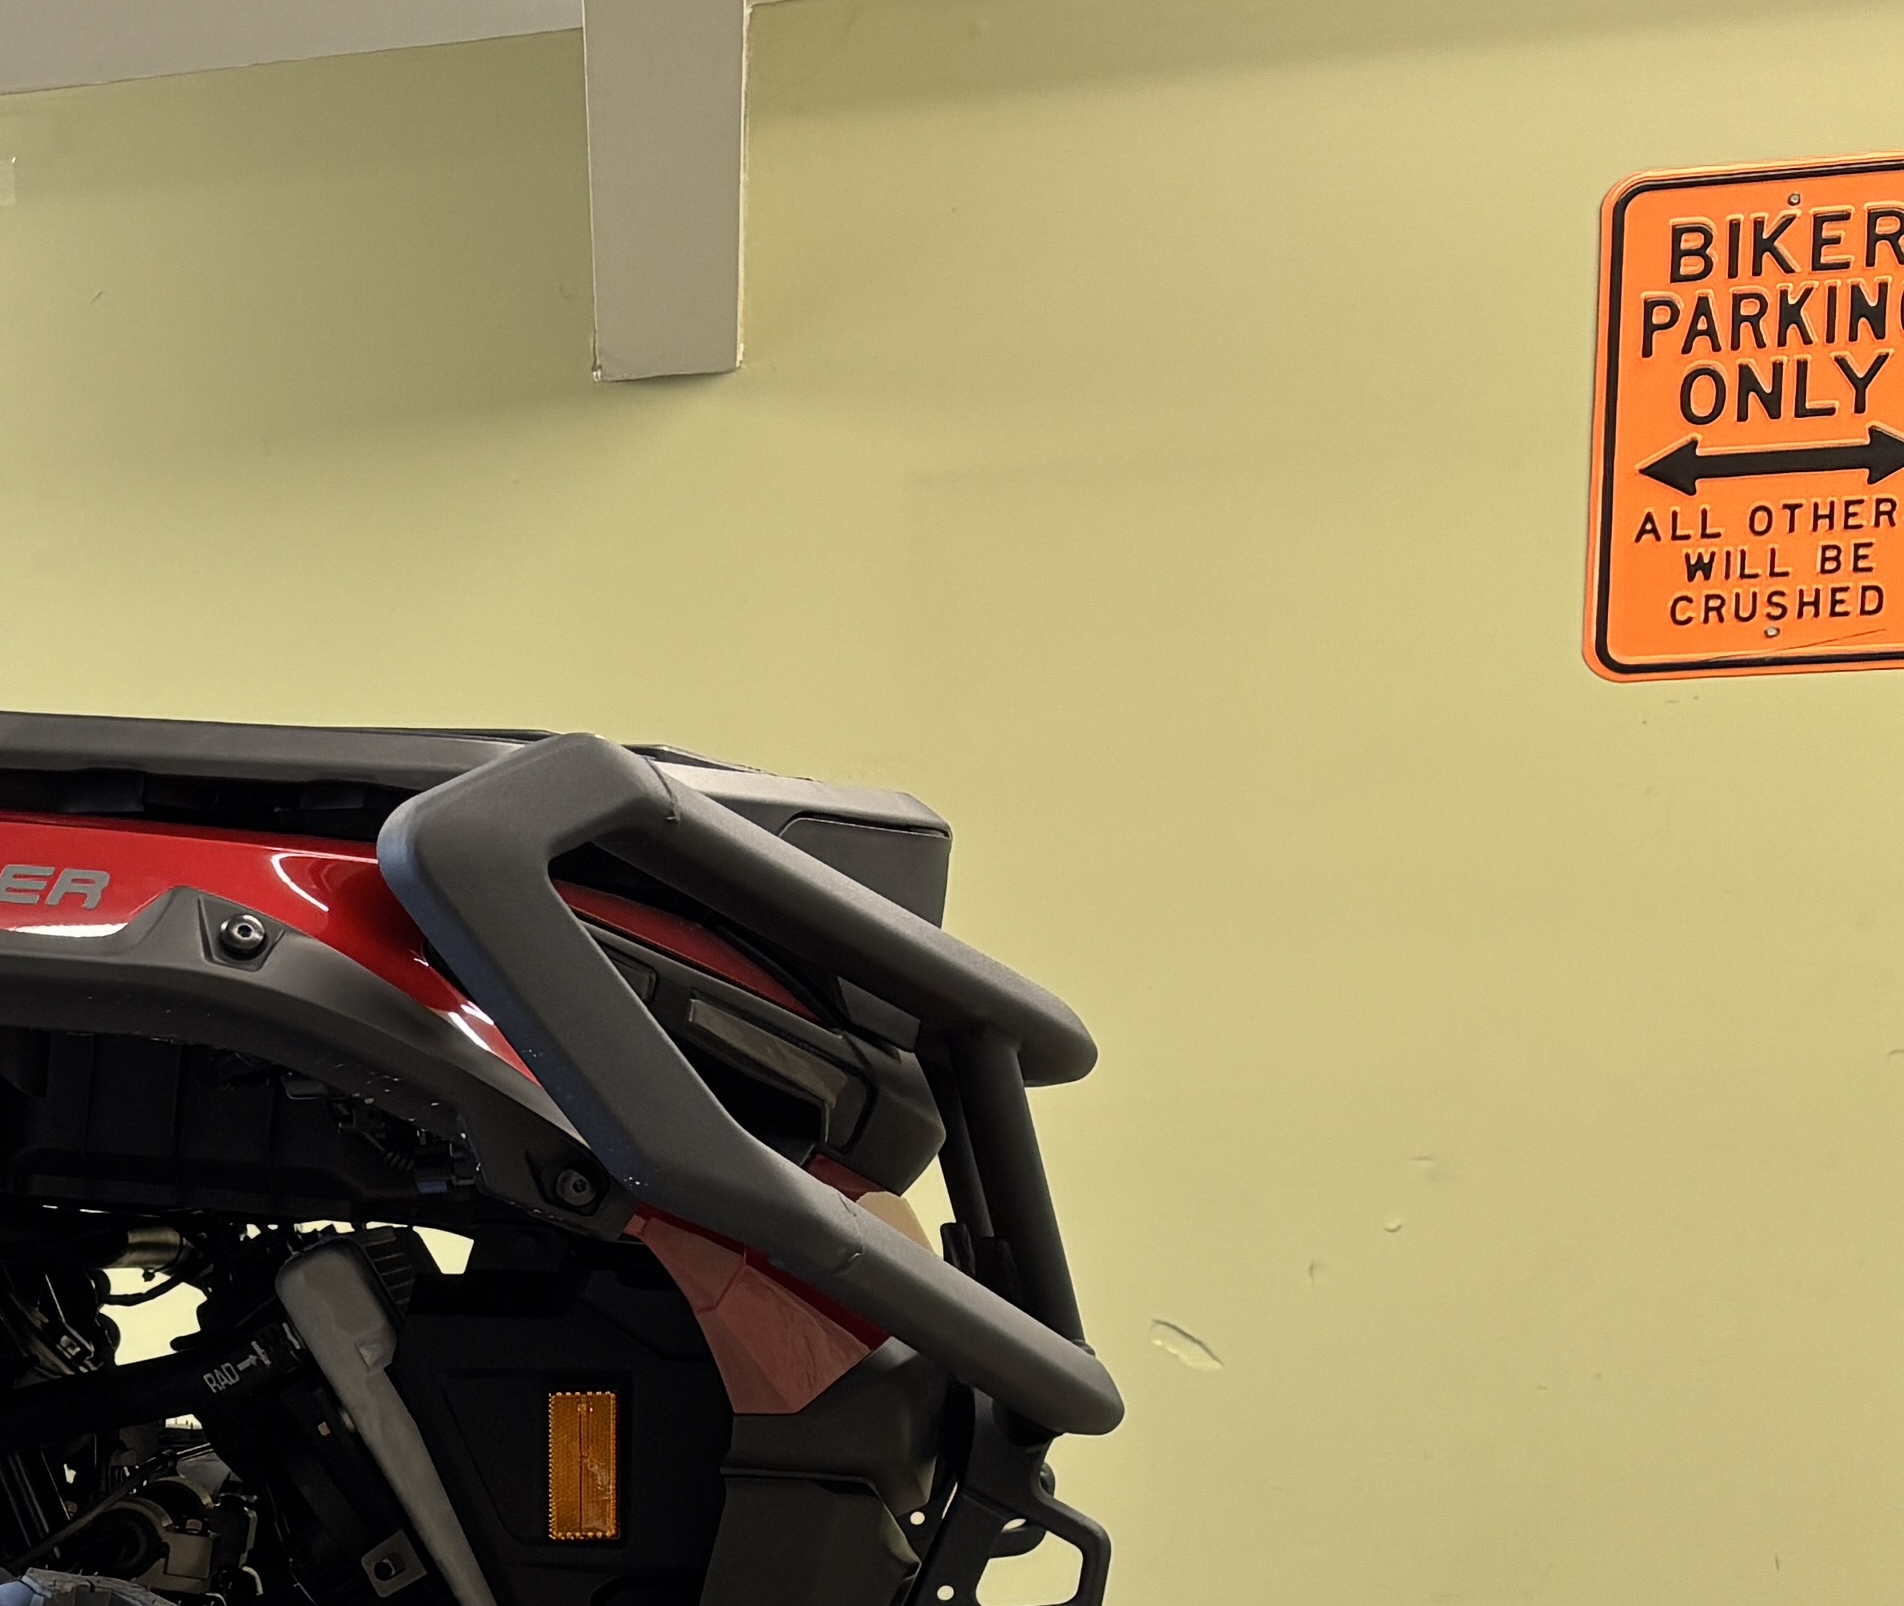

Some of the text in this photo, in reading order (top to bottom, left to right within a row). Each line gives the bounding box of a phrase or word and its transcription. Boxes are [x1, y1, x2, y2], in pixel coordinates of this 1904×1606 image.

[1640, 278, 1904, 358] PARKIN
[1679, 351, 1892, 426] ONLY
[1634, 507, 1723, 545] ALL
[1683, 541, 1875, 583] WILL BE
[1669, 585, 1885, 626] CRUSHED
[202, 1361, 241, 1394] RAD
